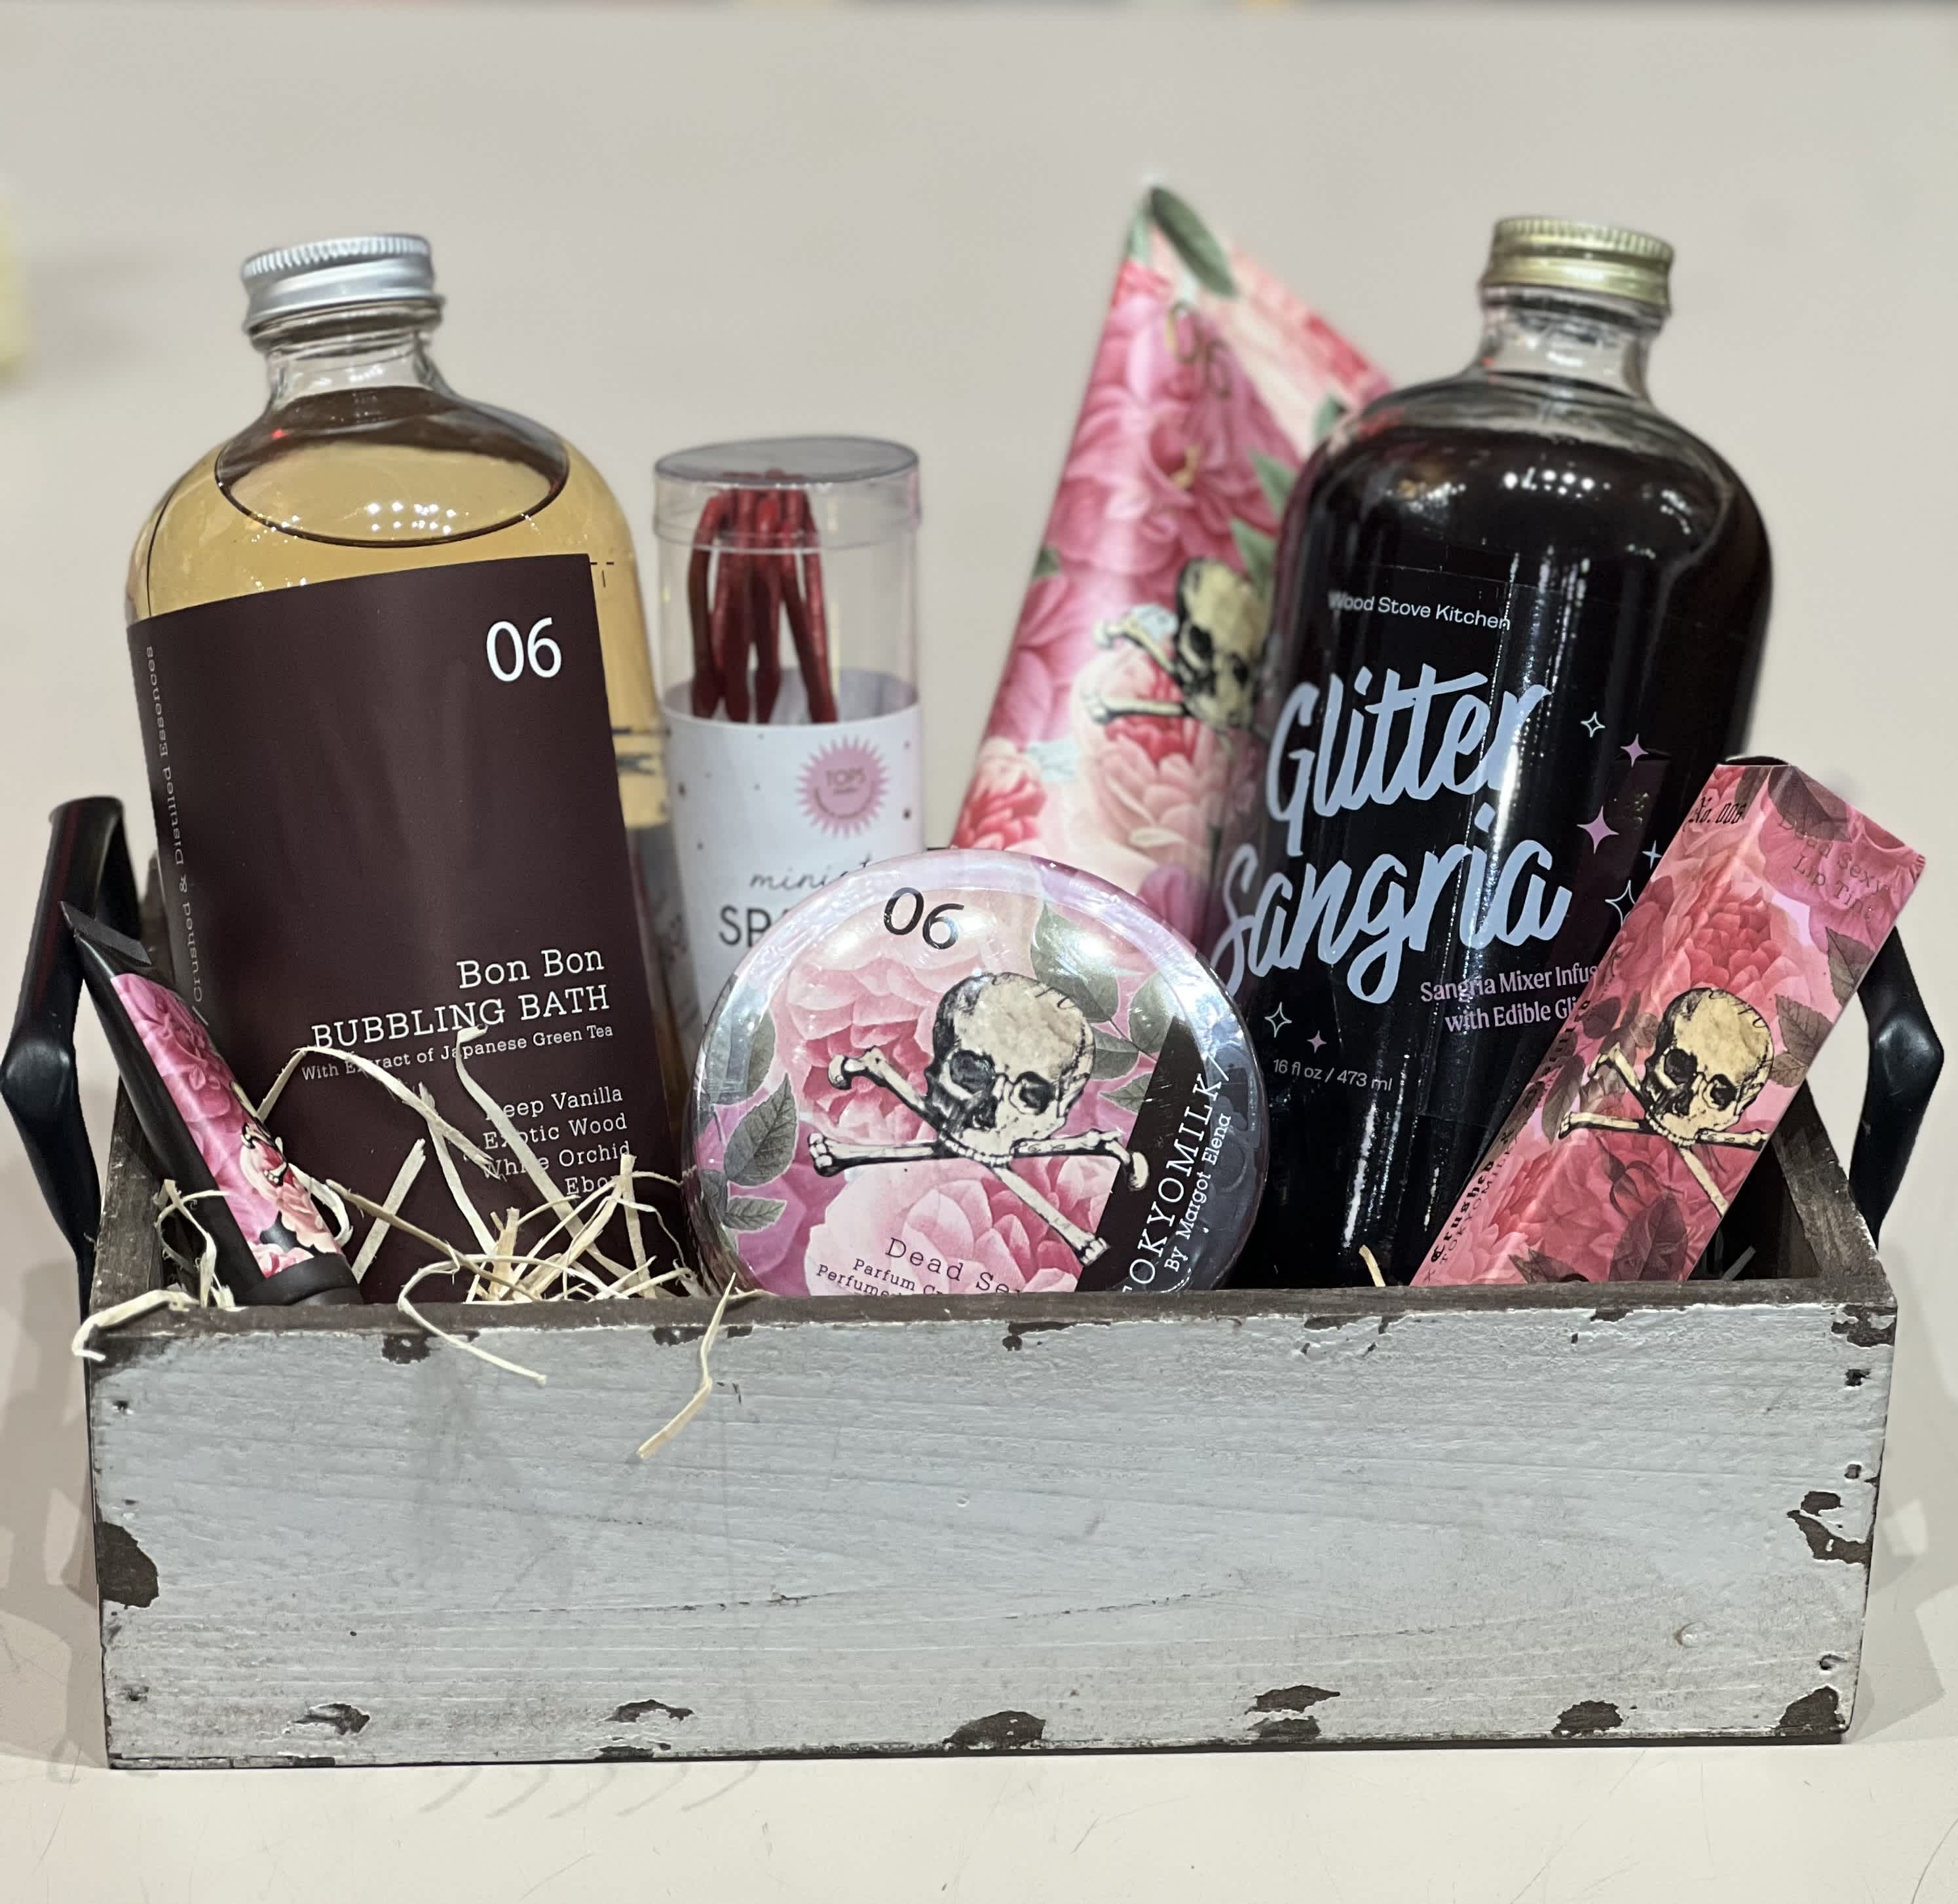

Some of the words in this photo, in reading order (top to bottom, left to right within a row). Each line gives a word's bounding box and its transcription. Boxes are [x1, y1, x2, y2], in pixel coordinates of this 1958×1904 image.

[1328, 590, 1374, 611] Wood
[1378, 597, 1431, 618] Stove
[1435, 604, 1511, 630] Kitchen
[486, 617, 561, 681] 06
[146, 646, 168, 756] Essences
[1266, 663, 1553, 858] Glitter
[163, 765, 184, 865] Distilled
[179, 875, 188, 893] &
[1794, 855, 1826, 886] Lip
[883, 887, 965, 950] 06
[1212, 802, 1572, 1004] Sangria
[182, 902, 202, 1002] Crushed
[457, 960, 531, 989] Bon
[541, 949, 605, 977] Bon
[1420, 973, 1496, 1004] Sangria
[1499, 970, 1553, 994] Mixer
[311, 999, 506, 1050] BUBBLING
[518, 984, 610, 1021] BATH
[1444, 1007, 1490, 1033] with
[1493, 1000, 1551, 1027] Edible
[301, 1063, 339, 1080] With
[417, 1048, 434, 1063] of
[440, 1038, 527, 1059] Japanese
[533, 1031, 582, 1046] Green
[586, 1025, 613, 1039] Tea
[1273, 1059, 1289, 1074] 16
[1292, 1061, 1301, 1076] fl
[1304, 1067, 1323, 1080] oz
[1325, 1067, 1335, 1083] /
[1336, 1069, 1368, 1087] 473
[1371, 1077, 1393, 1092] ml
[485, 1099, 544, 1120] eep
[551, 1086, 623, 1110] Vanilla
[483, 1125, 559, 1150] Eotic
[568, 1113, 628, 1137] Wood
[1201, 1113, 1232, 1166] Elena
[559, 1141, 630, 1167] Orchid
[1175, 1171, 1211, 1240] Margot
[852, 1258, 916, 1291] Parfum
[885, 1237, 964, 1282] Dead
[975, 1271, 1021, 1295] Se
[1164, 1246, 1189, 1272] By
[816, 1263, 903, 1297] Perfume
